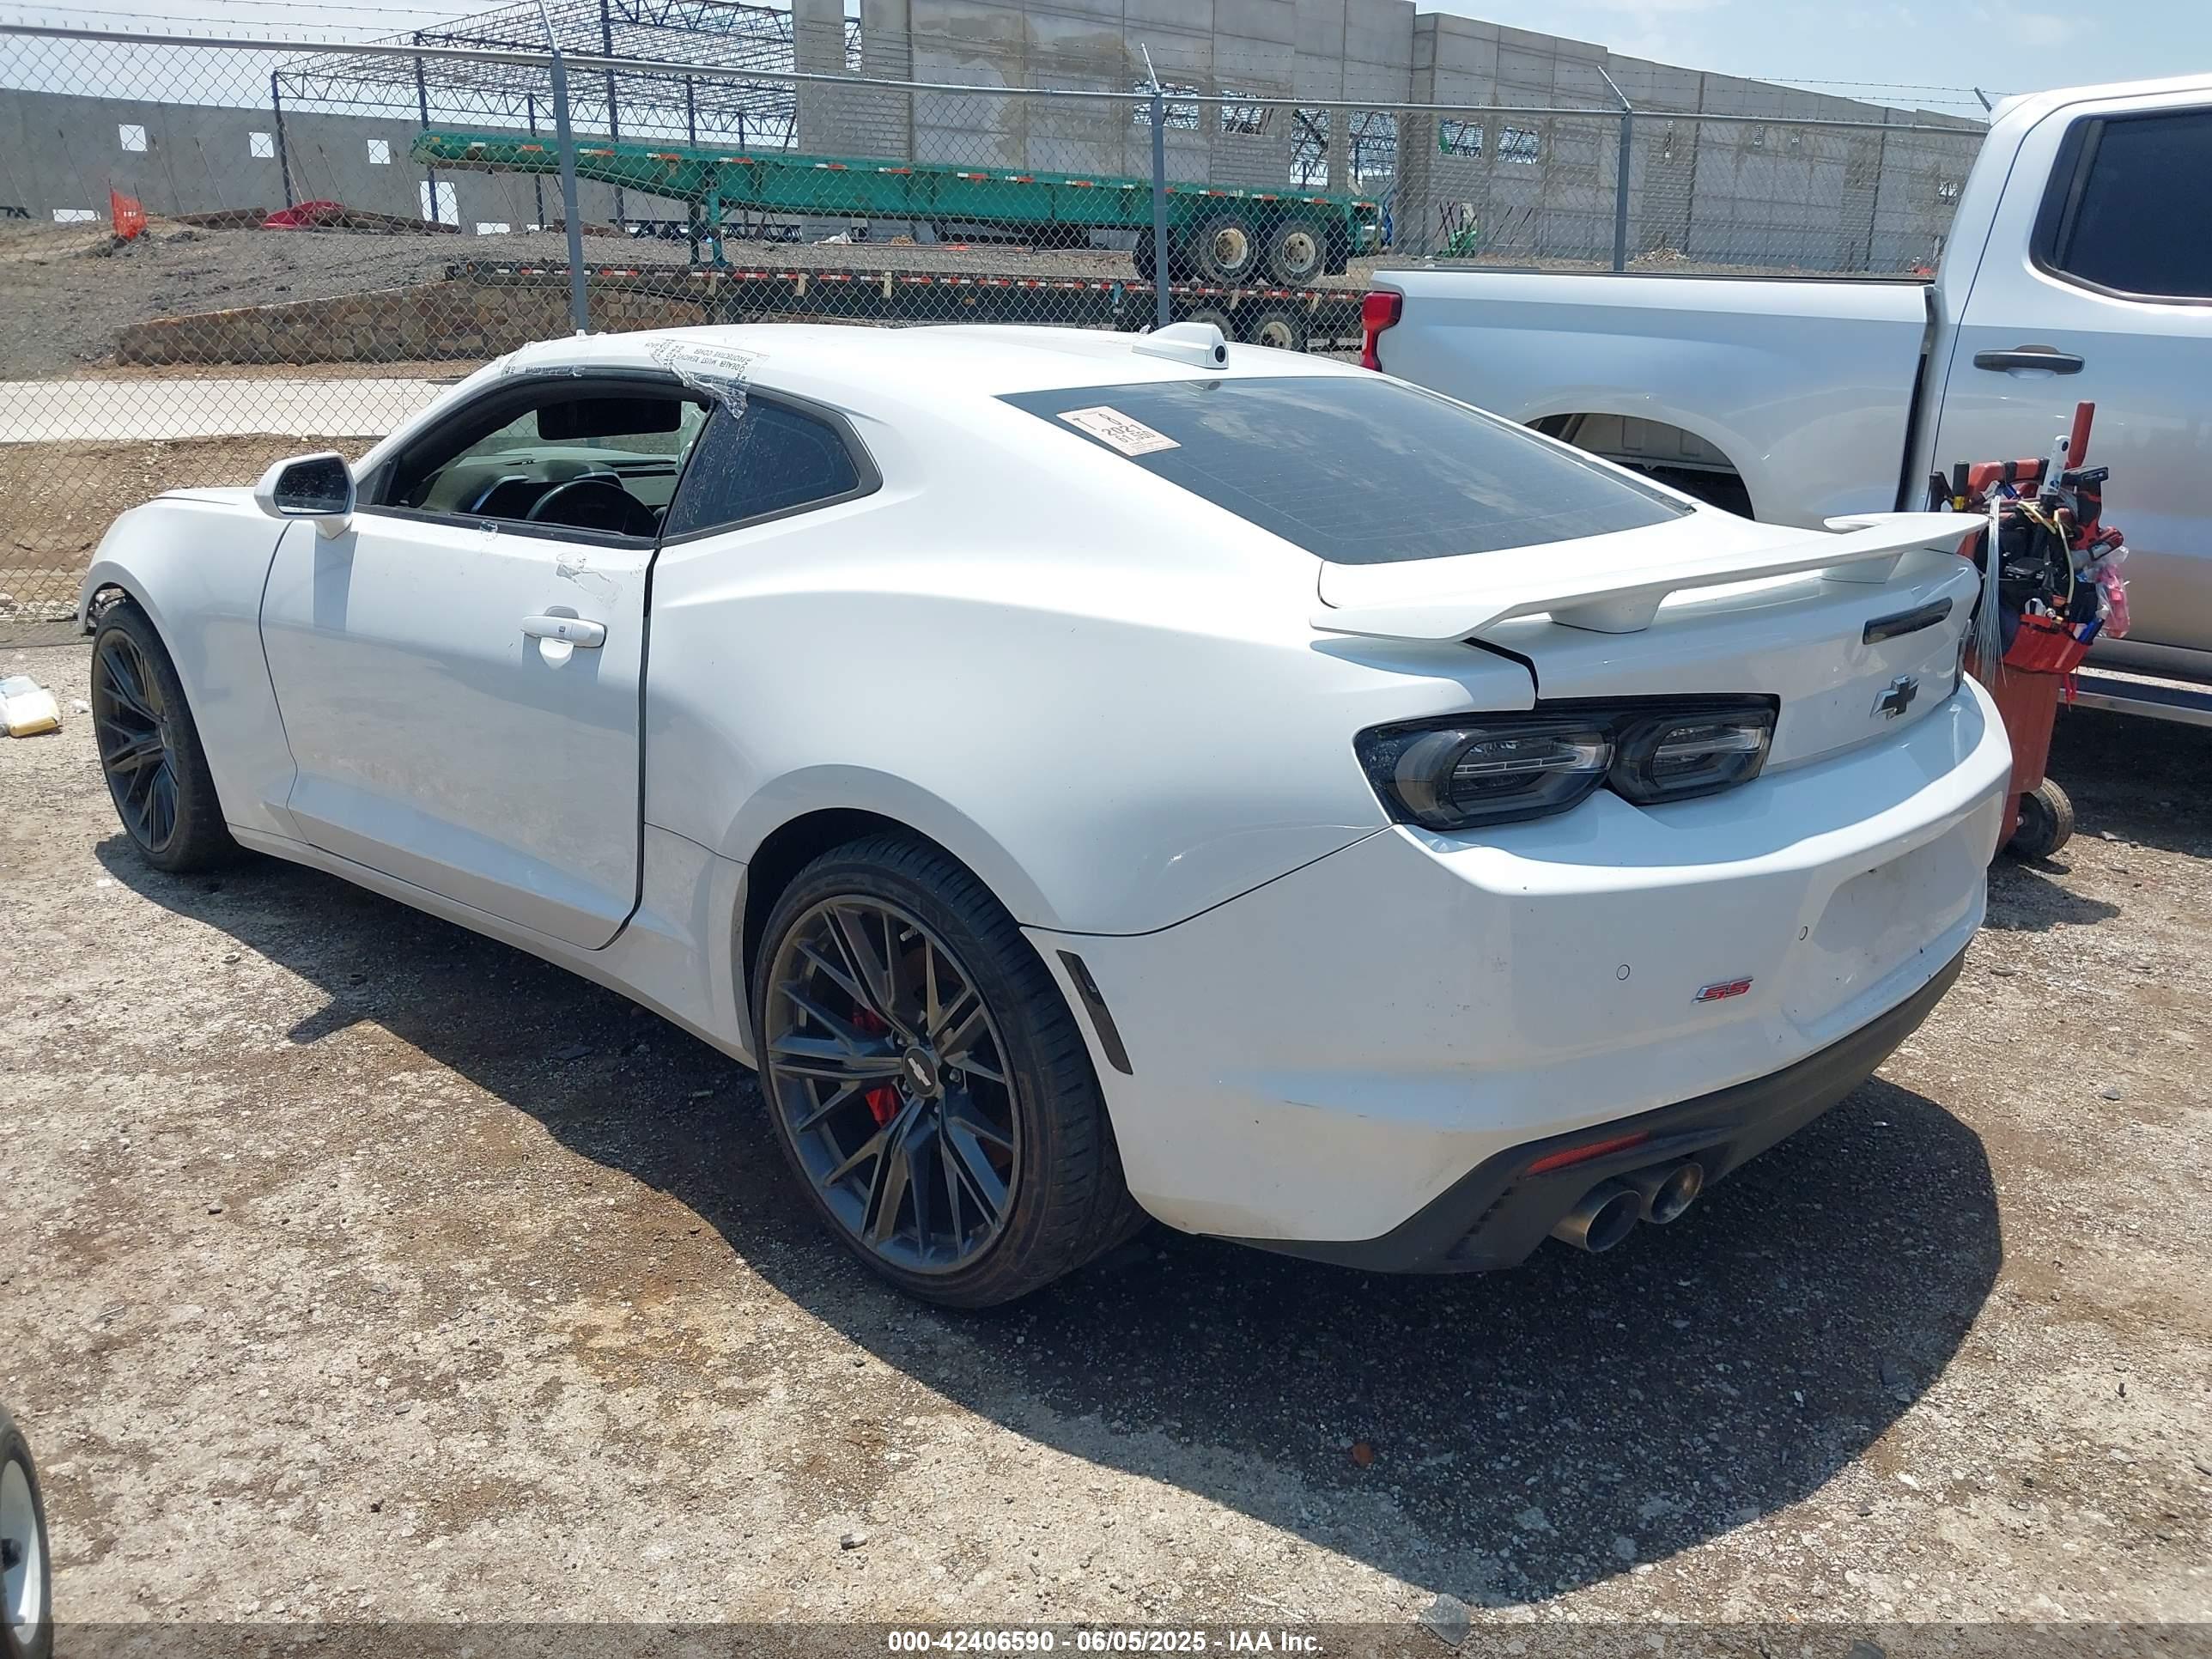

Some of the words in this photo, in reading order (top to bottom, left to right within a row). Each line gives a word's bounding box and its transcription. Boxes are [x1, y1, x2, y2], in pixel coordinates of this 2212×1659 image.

[720, 361, 742, 372] DEALER
[1101, 423, 1143, 436] 2021
[1695, 978, 1751, 1001] SS
